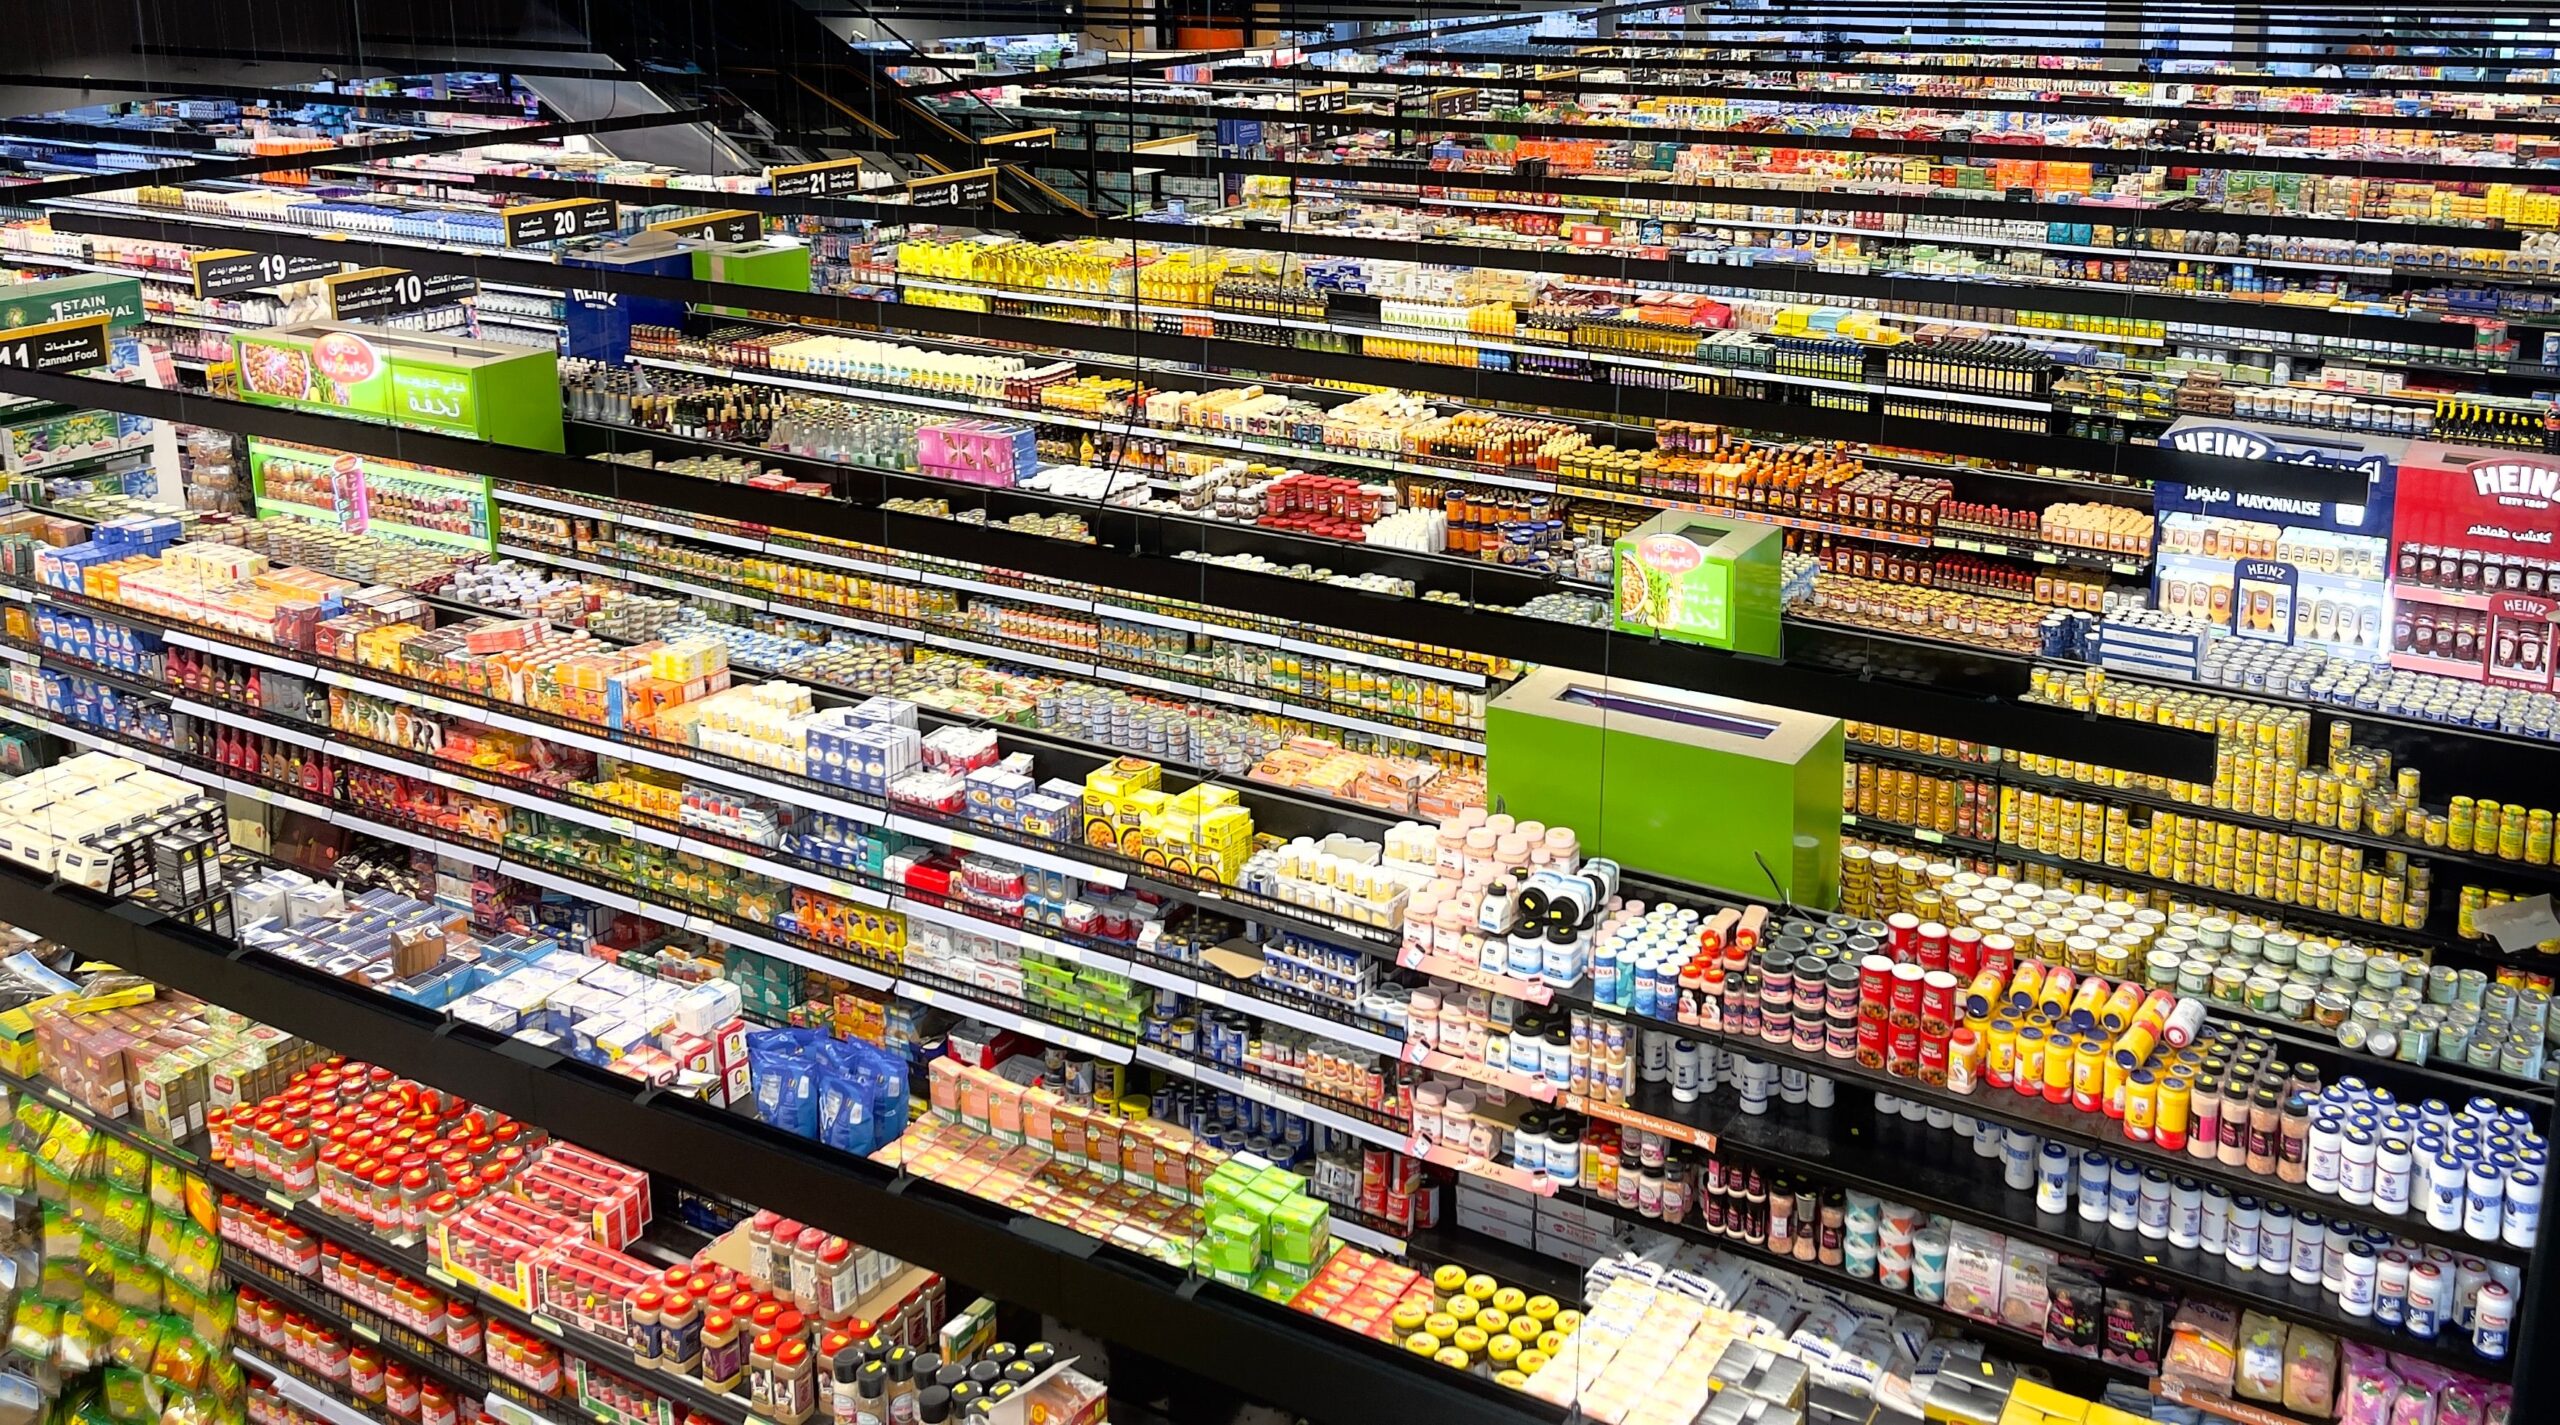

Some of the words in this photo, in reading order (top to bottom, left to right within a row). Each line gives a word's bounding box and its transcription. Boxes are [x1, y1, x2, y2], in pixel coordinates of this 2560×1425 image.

[1320, 95, 1329, 111] 24
[810, 172, 825, 194] 21
[950, 184, 958, 205] 8
[554, 210, 576, 236] 20
[584, 217, 610, 228] Shampoo
[518, 228, 546, 238] Shampoo
[704, 226, 714, 242] 9
[732, 232, 744, 242] Oils
[259, 254, 286, 282] 19
[207, 278, 221, 288] Soap
[246, 274, 254, 282] Oil
[425, 288, 446, 296] Sauces
[450, 282, 475, 292] Ketchup
[394, 276, 422, 305] 10
[62, 295, 106, 312] STAIN
[44, 338, 88, 352] معلبات
[0, 342, 30, 368] 11
[38, 352, 74, 368] Canned
[74, 348, 98, 360] Food
[408, 390, 461, 418] تحفة
[2174, 432, 2268, 460] HEINZ
[2473, 465, 2560, 504] HEIN
[2184, 484, 2231, 502] مايونيز
[2236, 492, 2321, 518] MAYONNAISE
[2466, 524, 2510, 538] طماطم
[2246, 564, 2286, 580] HEINZ
[2504, 600, 2547, 616] HEINZ
[2108, 1316, 2135, 1330] PINK
[2410, 1308, 2428, 1322] Salt
[2483, 1331, 2503, 1345] Salt
